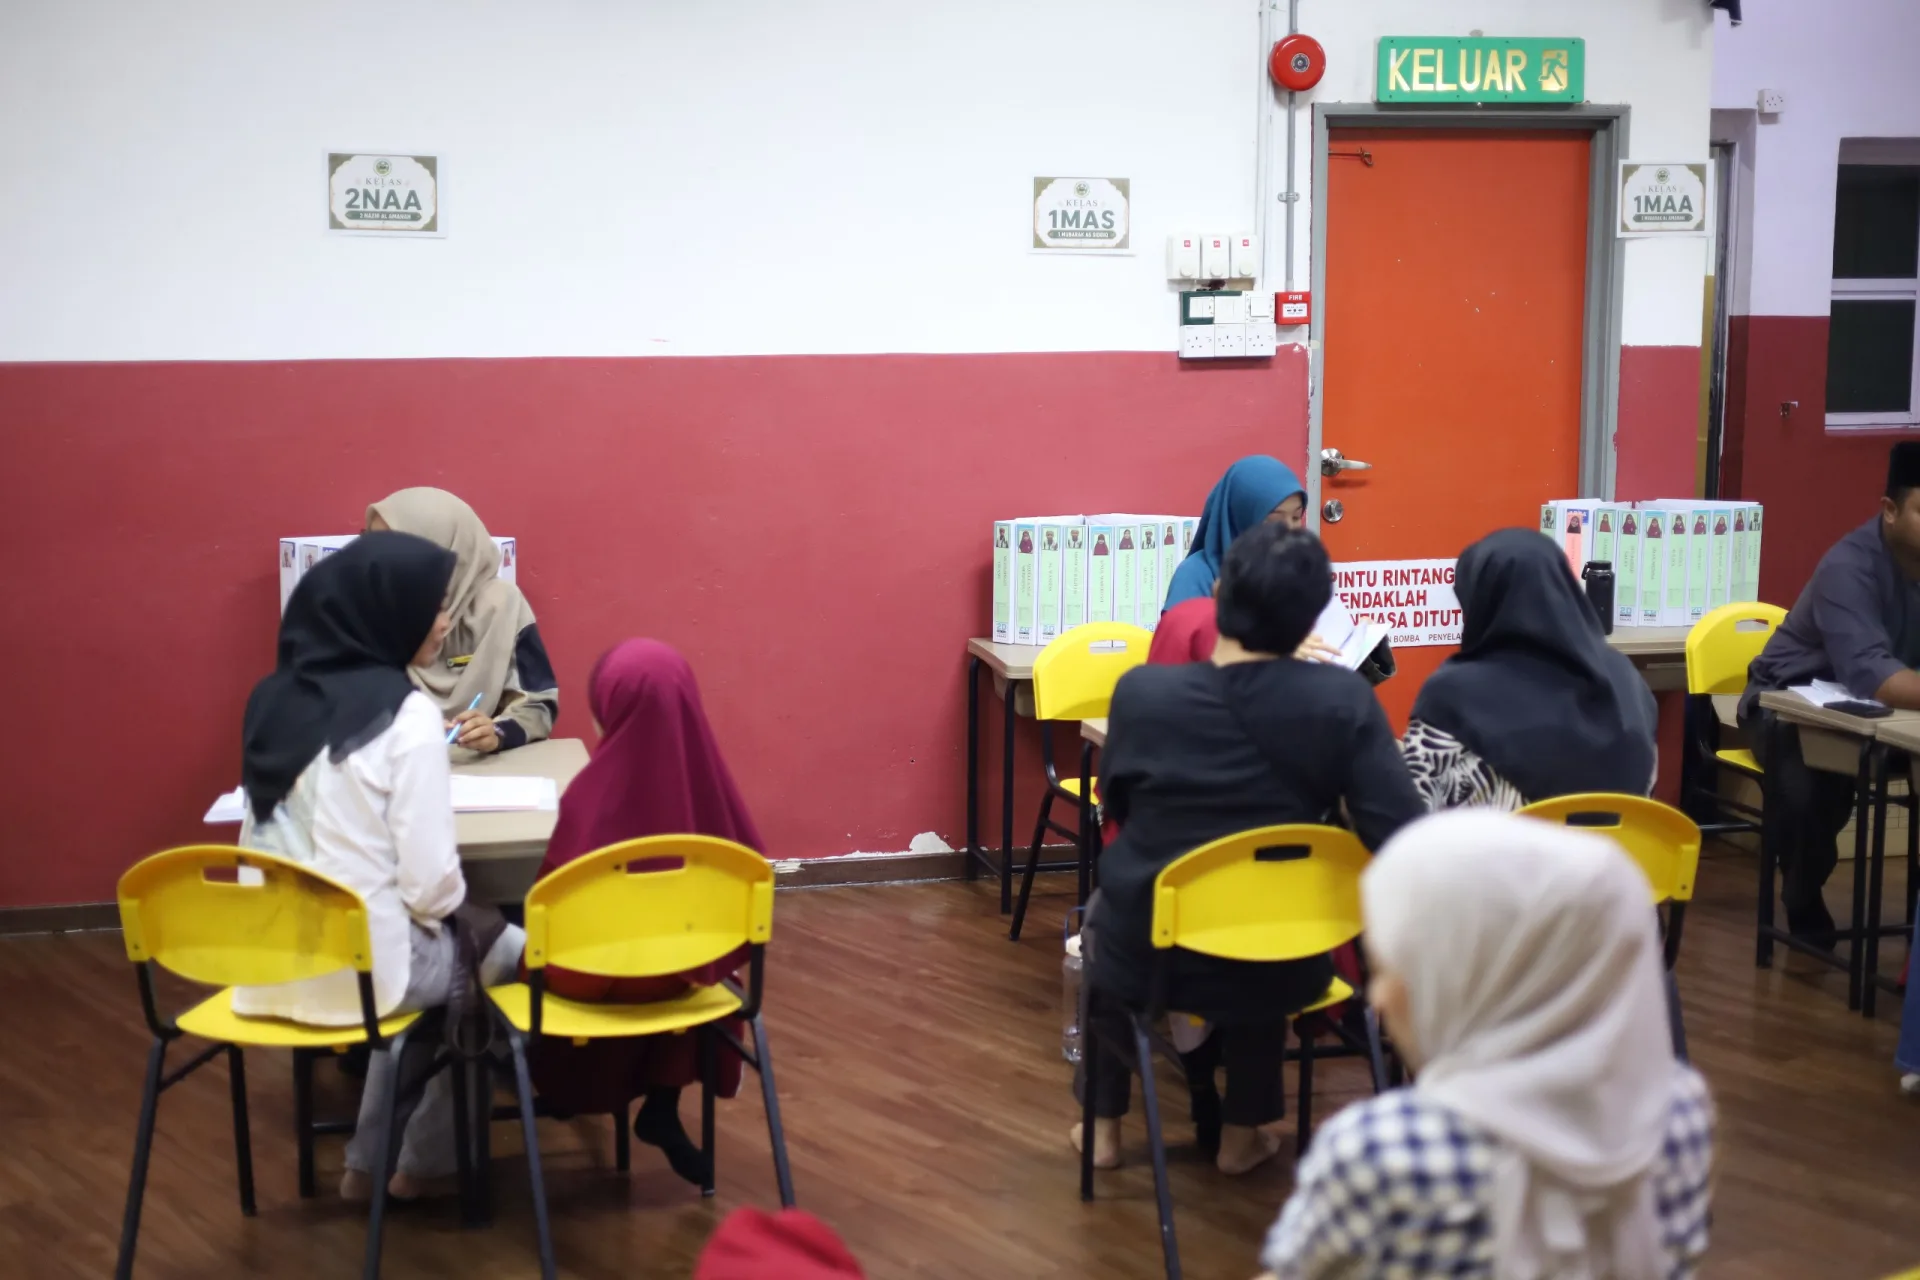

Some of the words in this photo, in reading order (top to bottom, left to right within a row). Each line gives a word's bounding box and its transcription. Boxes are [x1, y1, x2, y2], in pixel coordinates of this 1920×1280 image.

[1390, 48, 1528, 92] KELUAR
[365, 177, 402, 186] KELAS
[1648, 185, 1677, 193] KELAS
[345, 188, 422, 210] 2NAA
[1066, 199, 1098, 207] KELAS
[1634, 195, 1693, 213] 1MAA
[1048, 210, 1115, 229] 1MAS
[1383, 568, 1454, 586] RINTANG
[1335, 590, 1427, 609] ENDAKLAH
[1413, 609, 1464, 628] DITUT
[1394, 634, 1420, 643] BOMBA
[1428, 633, 1462, 641] PENYELA
